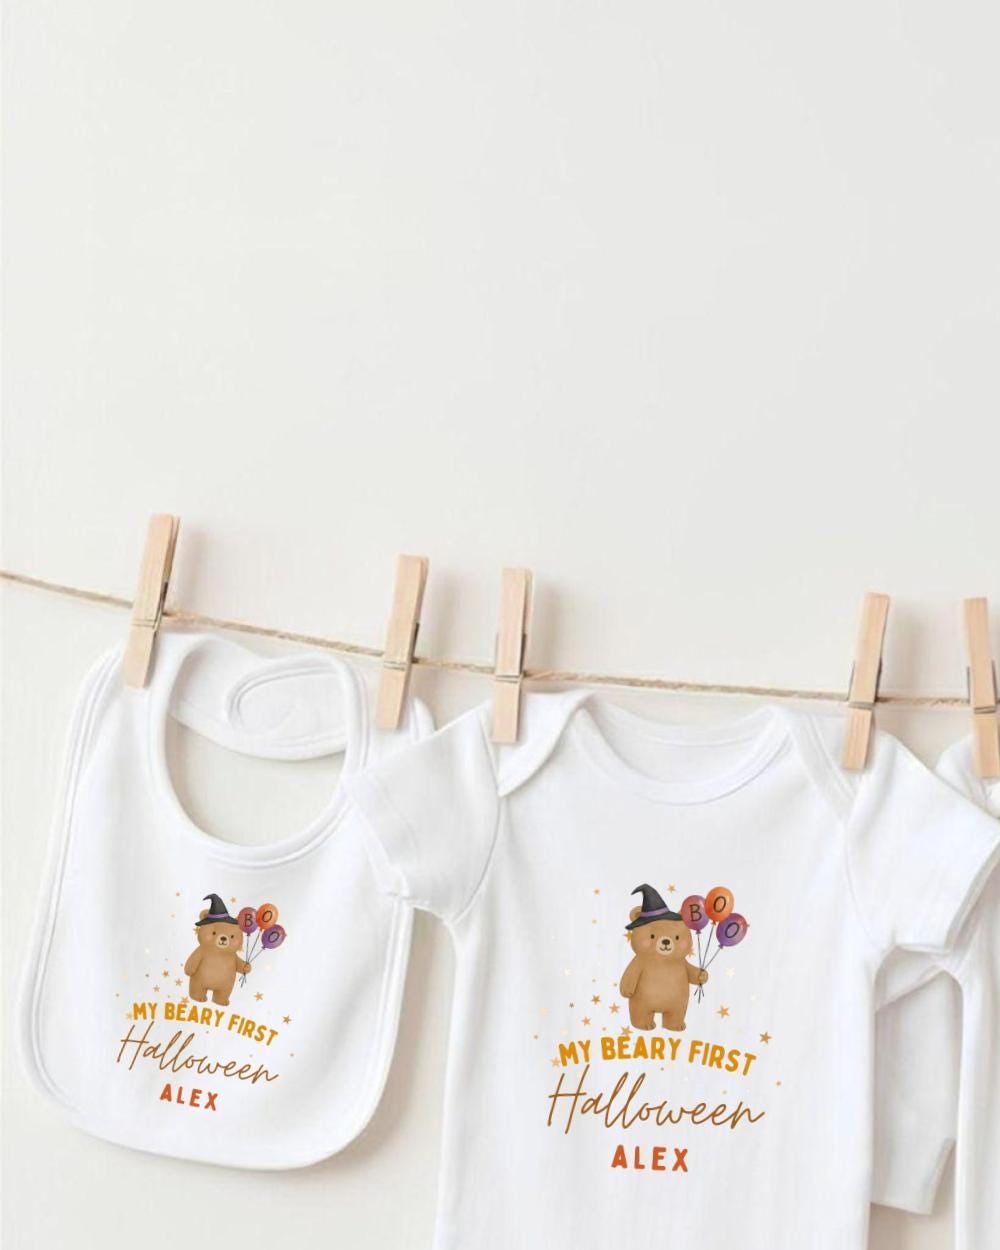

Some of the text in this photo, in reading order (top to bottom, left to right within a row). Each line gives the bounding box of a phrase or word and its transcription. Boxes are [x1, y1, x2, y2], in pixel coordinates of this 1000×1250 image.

[133, 1002, 278, 1046] MY BEARY FIRST
[117, 1021, 279, 1084] Halloween
[558, 1036, 757, 1076] MY BEARY FIRST
[160, 1083, 218, 1111] ALEX
[547, 1064, 765, 1134] Halloween
[611, 1145, 688, 1172] ALEX
